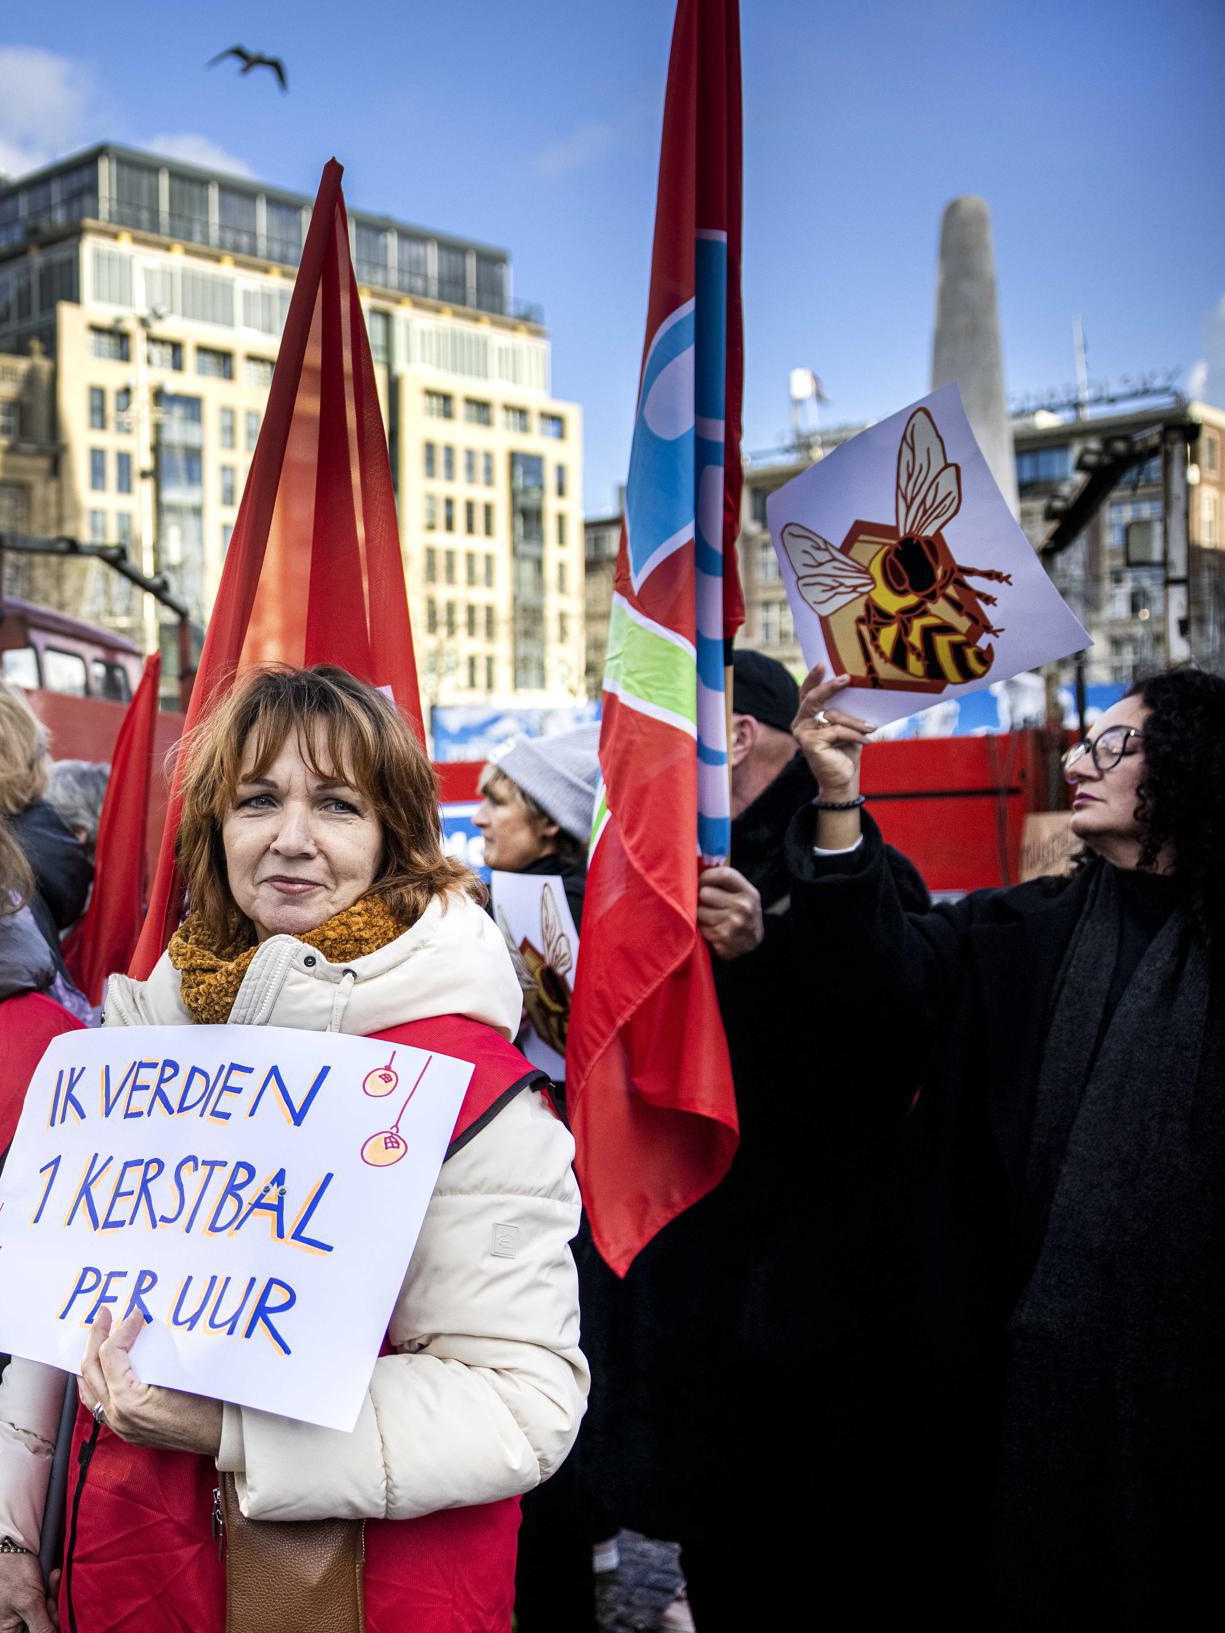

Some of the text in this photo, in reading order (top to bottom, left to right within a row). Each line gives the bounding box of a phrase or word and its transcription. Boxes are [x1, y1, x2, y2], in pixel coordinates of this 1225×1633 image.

[47, 1058, 332, 1129] IK VERDIEN
[31, 1152, 335, 1254] 1 KERSTBAL
[57, 1266, 297, 1356] PER UUR
